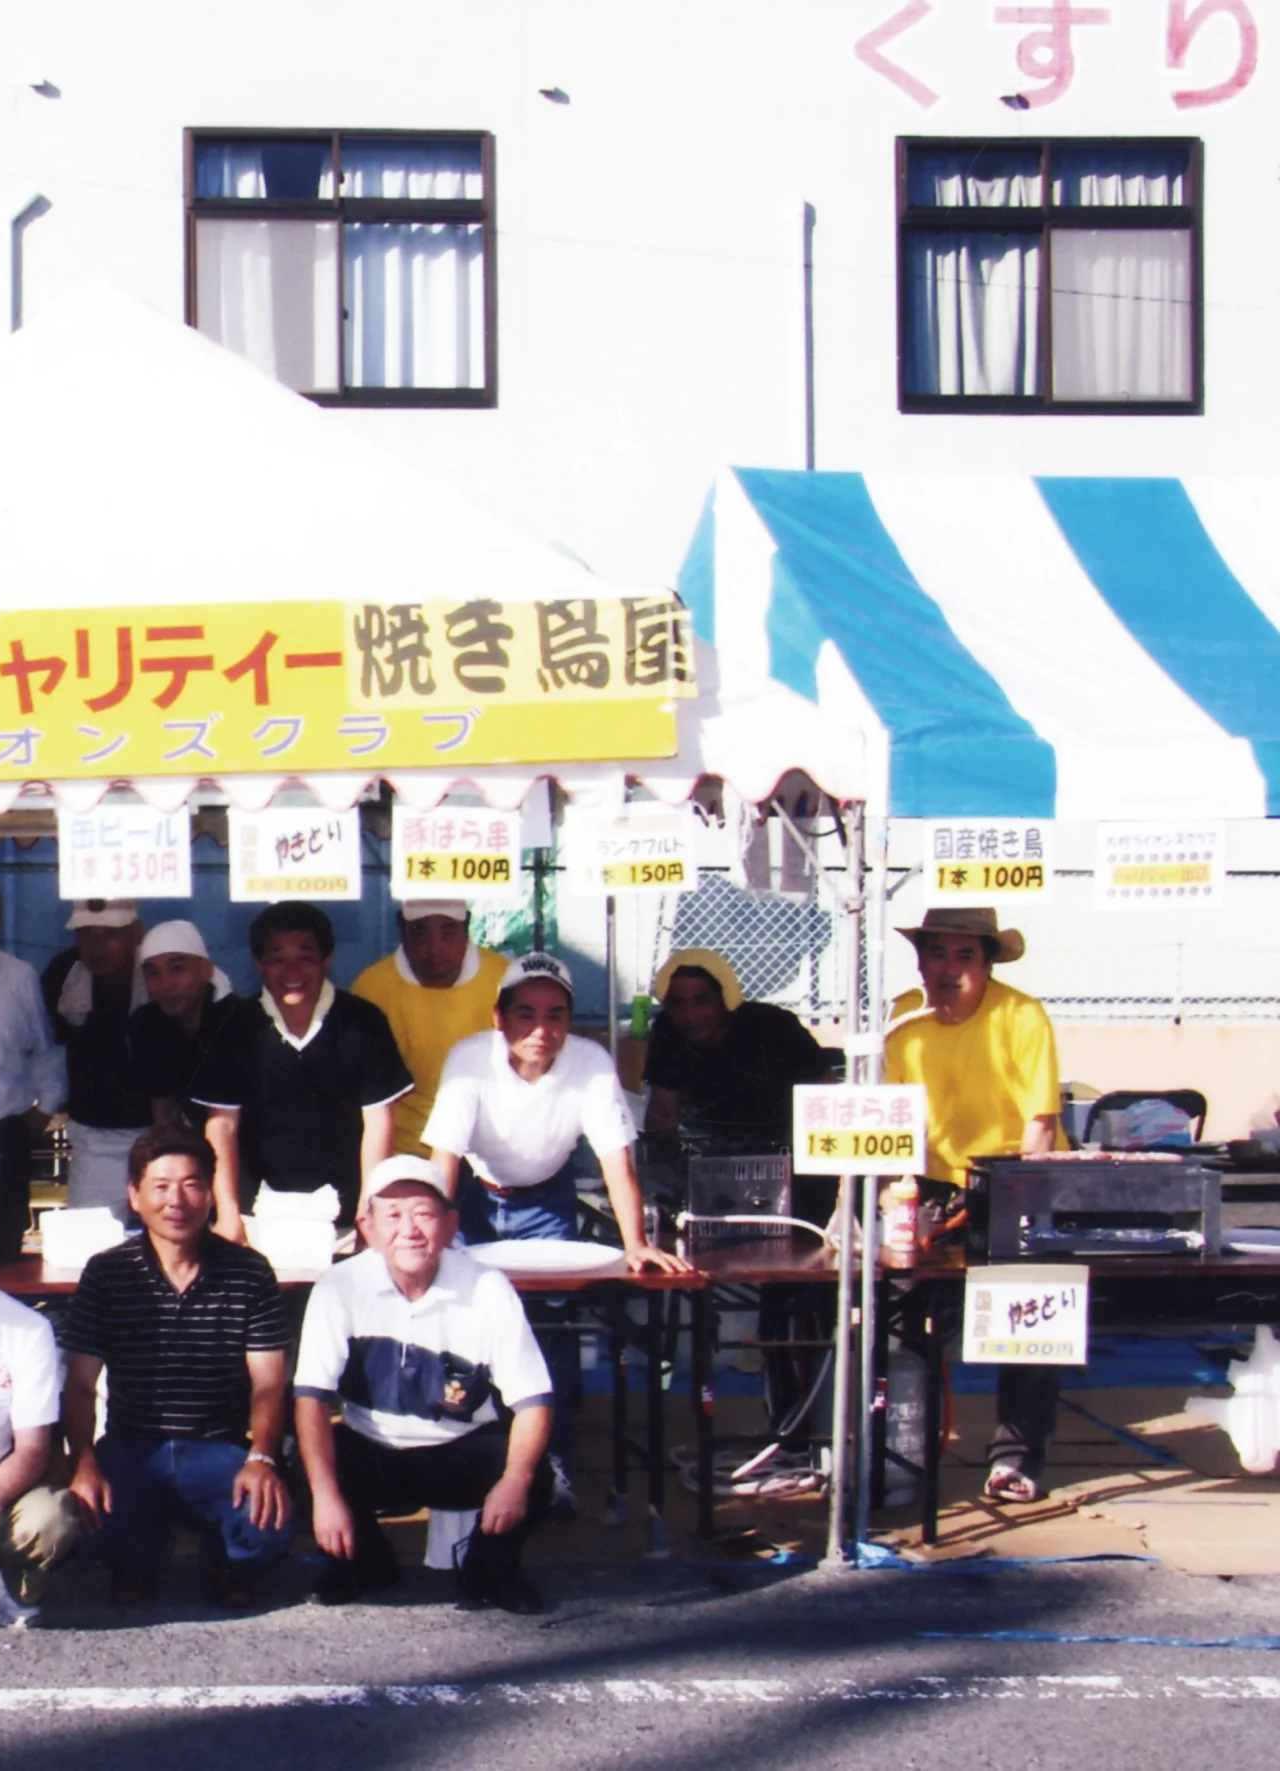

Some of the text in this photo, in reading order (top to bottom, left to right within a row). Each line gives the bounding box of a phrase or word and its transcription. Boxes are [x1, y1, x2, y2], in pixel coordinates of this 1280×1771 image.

[853, 0, 1259, 109] くすり
[70, 817, 179, 851] 缶ビール
[275, 820, 341, 869] やきとり
[934, 827, 1043, 859] 国産焼き鳥
[450, 858, 510, 881] 100円
[983, 865, 1044, 888] 100円
[852, 1134, 914, 1157] 100円
[1008, 1287, 1076, 1336] やきとり
